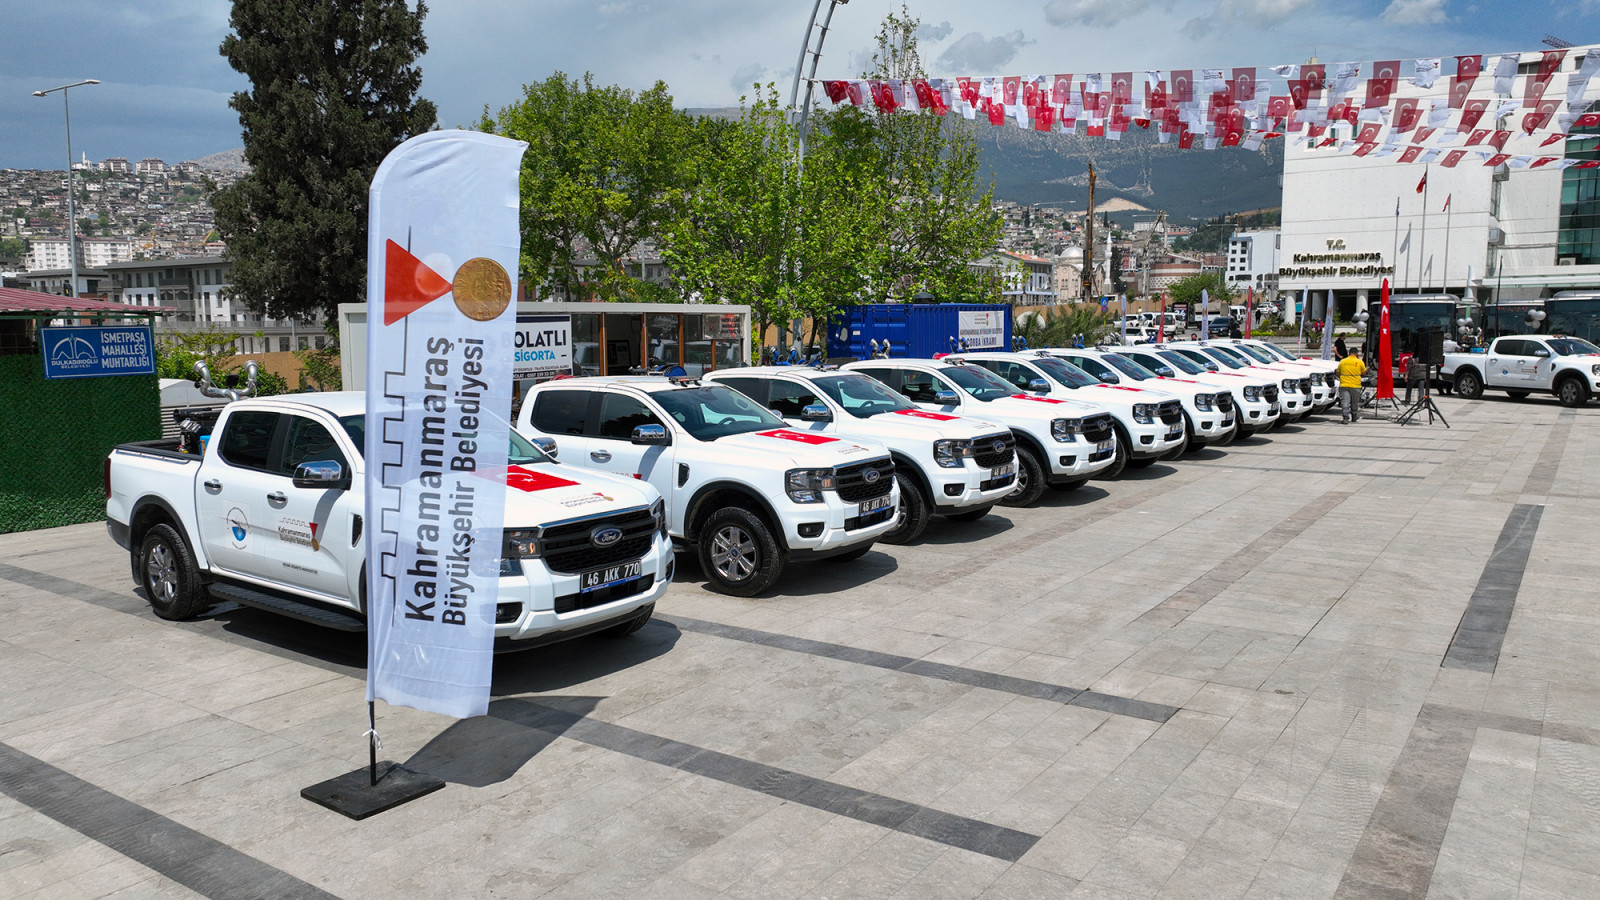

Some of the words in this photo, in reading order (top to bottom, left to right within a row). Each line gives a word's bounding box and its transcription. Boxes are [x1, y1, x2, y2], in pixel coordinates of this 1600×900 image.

[1326, 239, 1346, 250] T.C.
[1293, 252, 1382, 264] Kahramanmaraş
[1278, 266, 1338, 279] Büyükşehir
[1339, 265, 1395, 278] Belediyes
[100, 331, 146, 346] İSMETPAŞA
[515, 329, 566, 348] OLATLI
[101, 343, 147, 356] MAHALLESİ
[514, 349, 556, 362] SİGORTA
[101, 355, 150, 369] MUHTARLIĞI
[450, 337, 488, 472] Belediyesi
[405, 336, 455, 621] Kahramanmaraş
[442, 480, 476, 626] Büyükşehir
[587, 572, 599, 586] 46
[603, 567, 620, 583] AKK
[624, 562, 639, 577] 770
